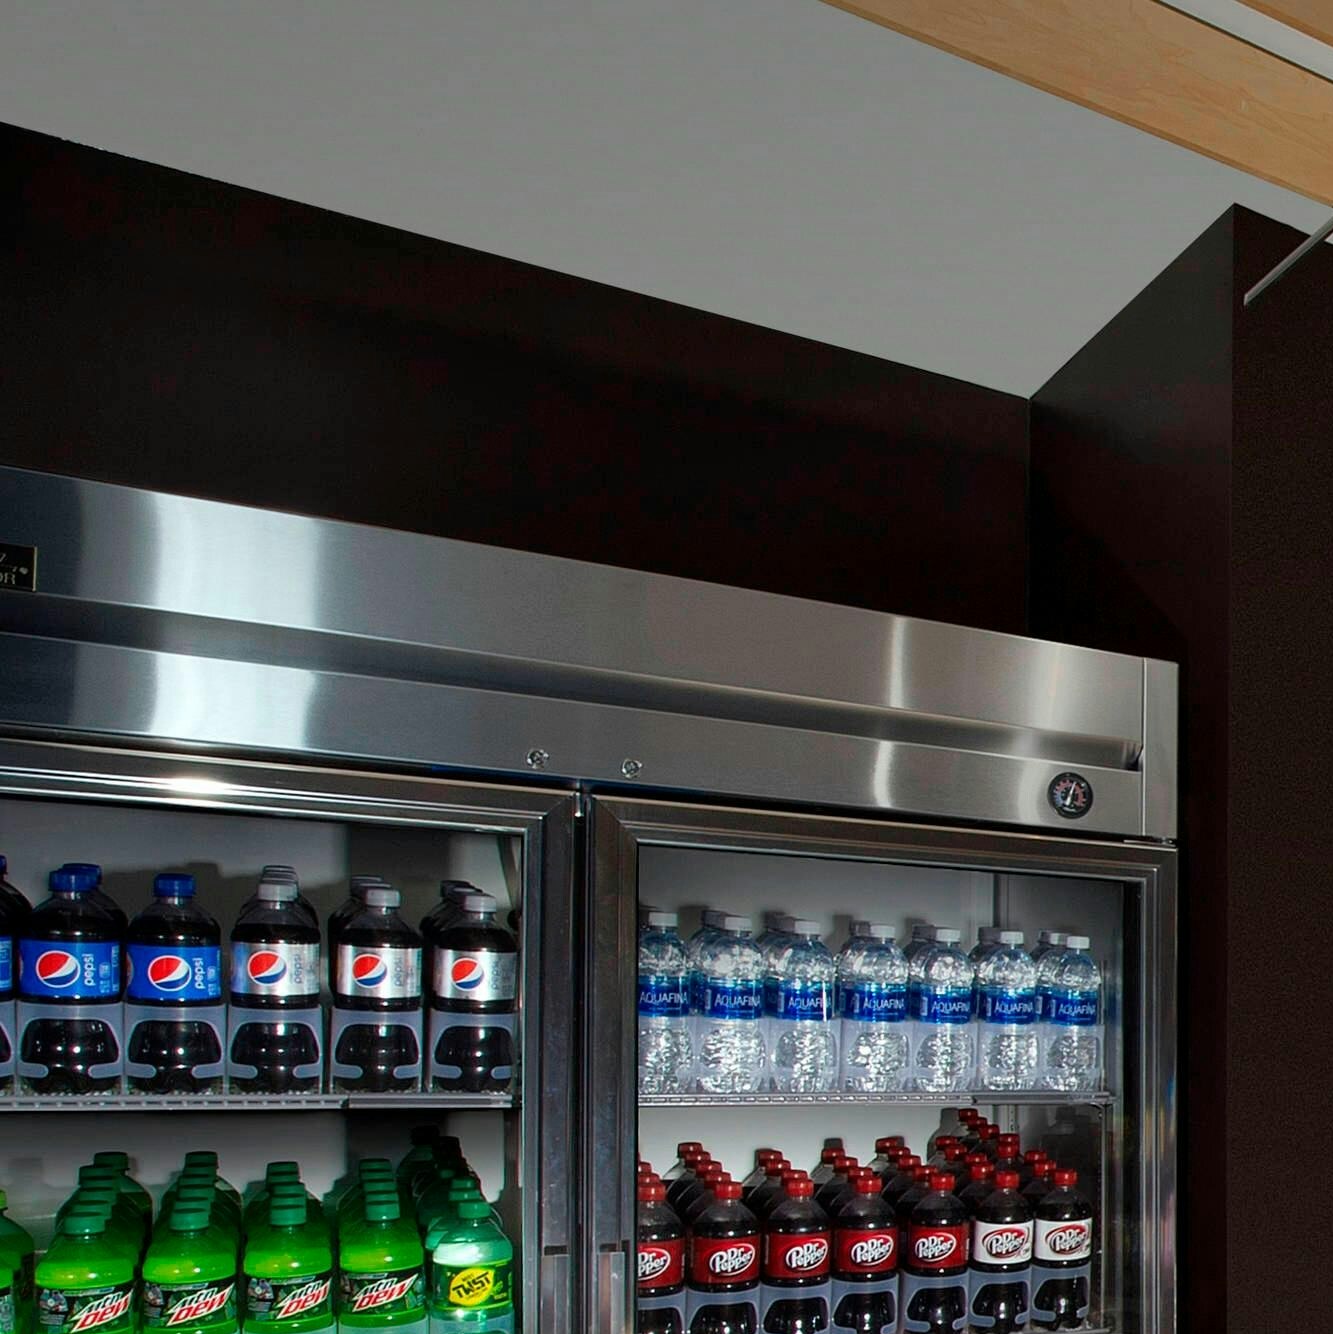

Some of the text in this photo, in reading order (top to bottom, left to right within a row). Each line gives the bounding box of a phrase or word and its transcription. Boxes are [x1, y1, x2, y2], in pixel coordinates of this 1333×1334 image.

[83, 953, 95, 987] pepsi
[193, 957, 206, 990] pepsi
[640, 992, 687, 1005] AQUAFINA
[855, 1241, 891, 1263] Pepper
[918, 1238, 953, 1260] Pepper
[991, 1234, 1026, 1254] Pepper
[1054, 1231, 1088, 1251] Pepper
[714, 1250, 753, 1273] Pepper
[790, 1246, 828, 1268] Pepper
